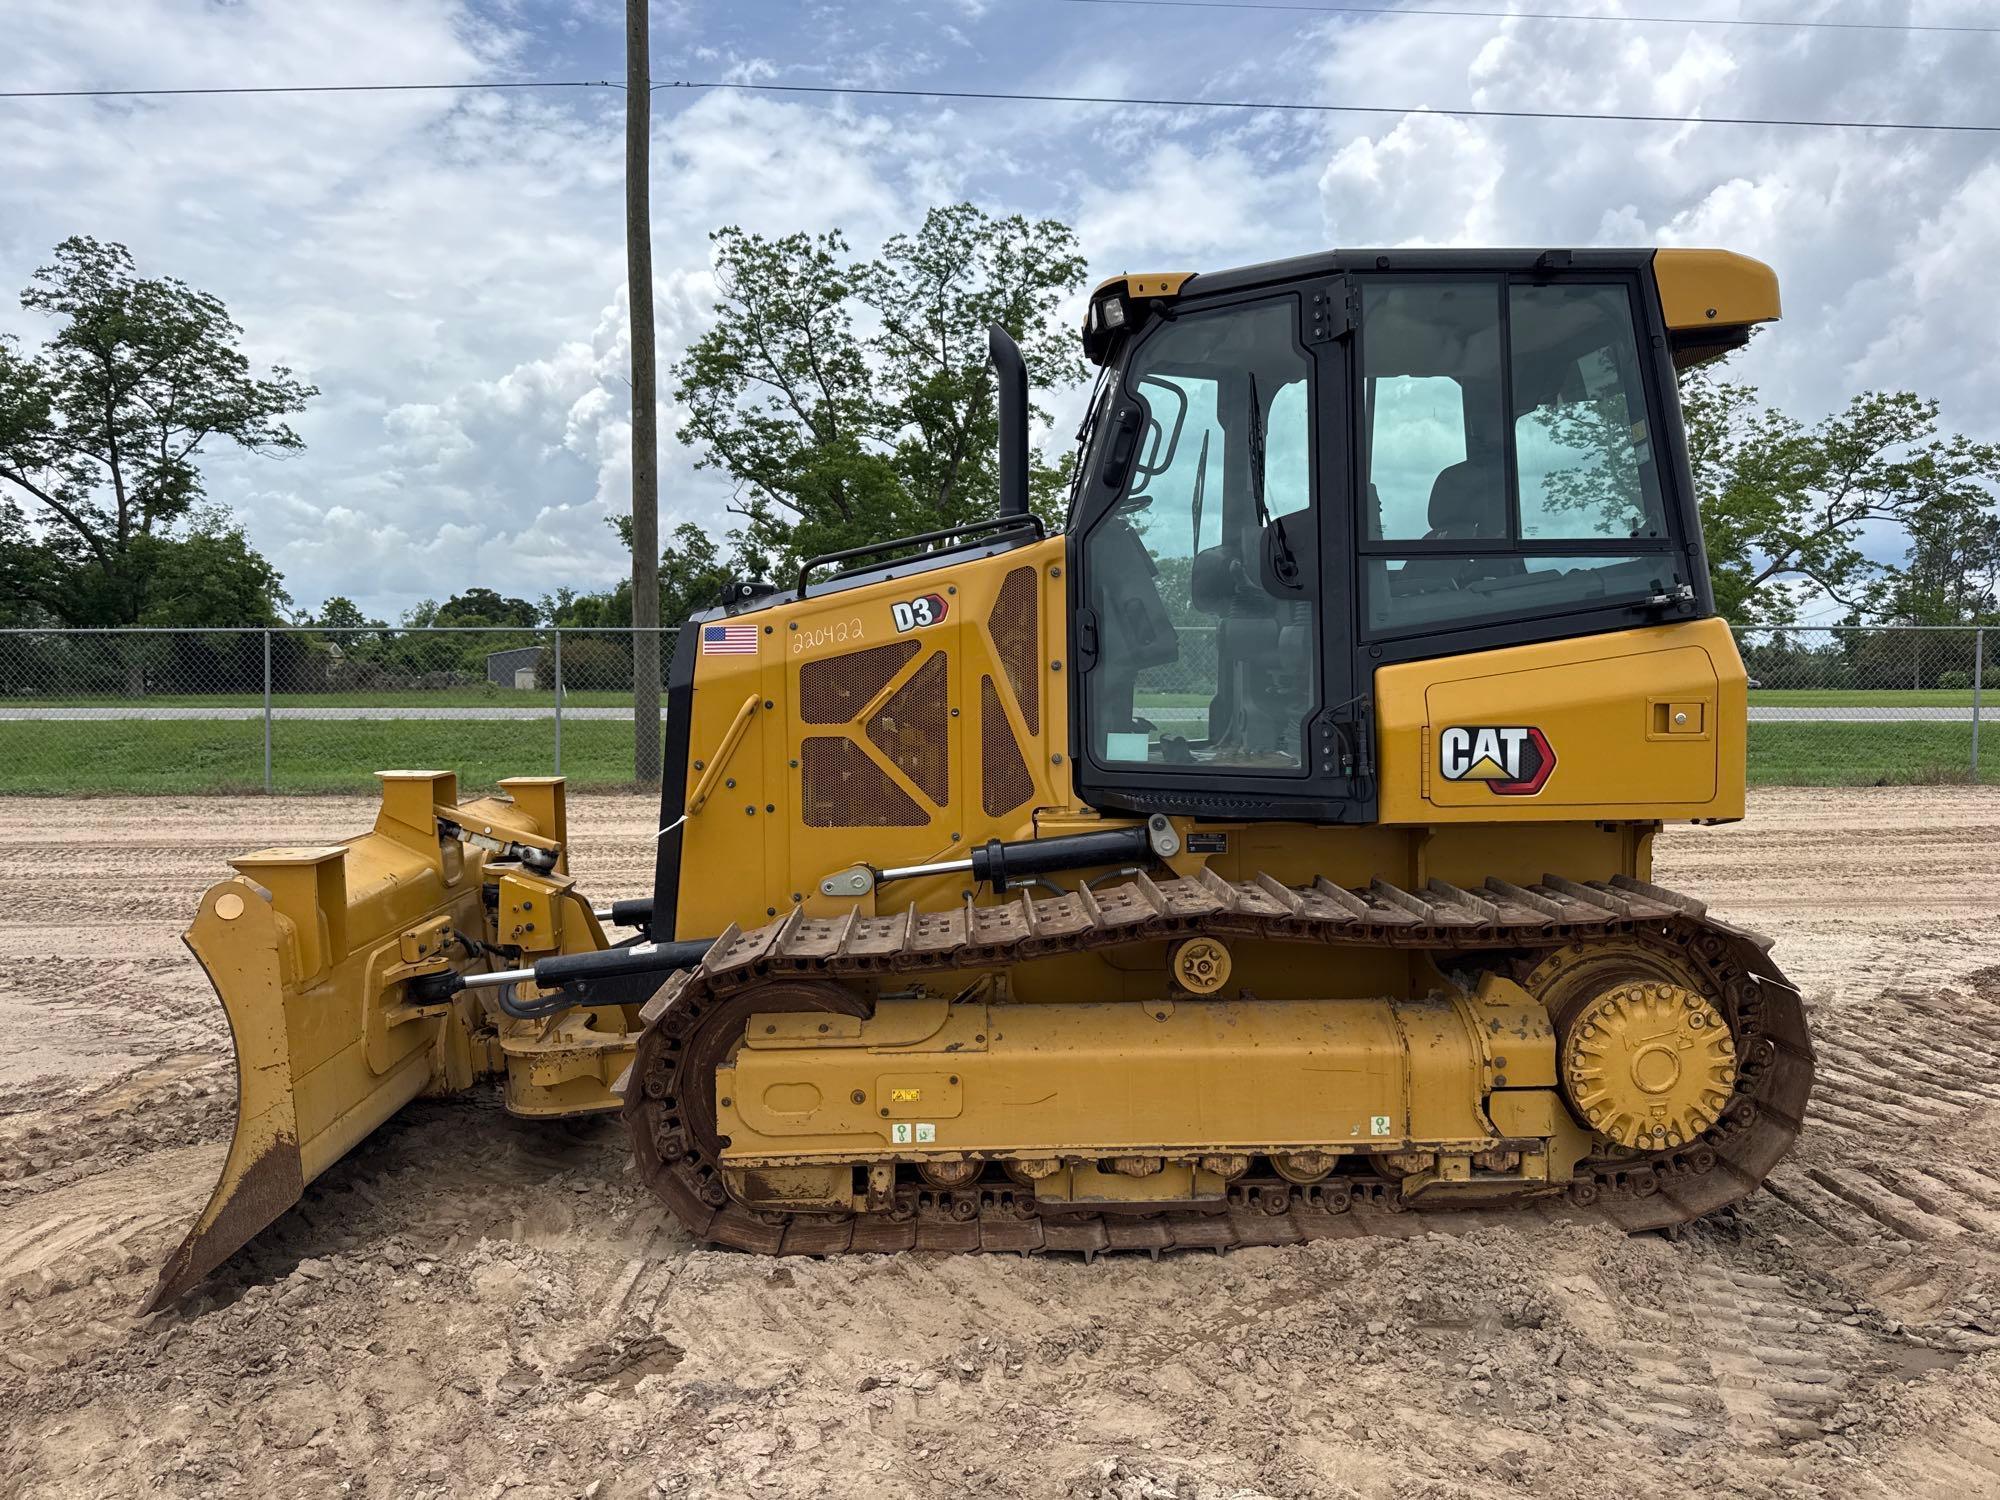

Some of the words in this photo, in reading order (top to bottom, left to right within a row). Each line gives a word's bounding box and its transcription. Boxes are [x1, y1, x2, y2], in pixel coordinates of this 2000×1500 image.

[892, 598, 933, 633] D3
[793, 618, 865, 654] 220422
[1441, 727, 1528, 779] CAT
